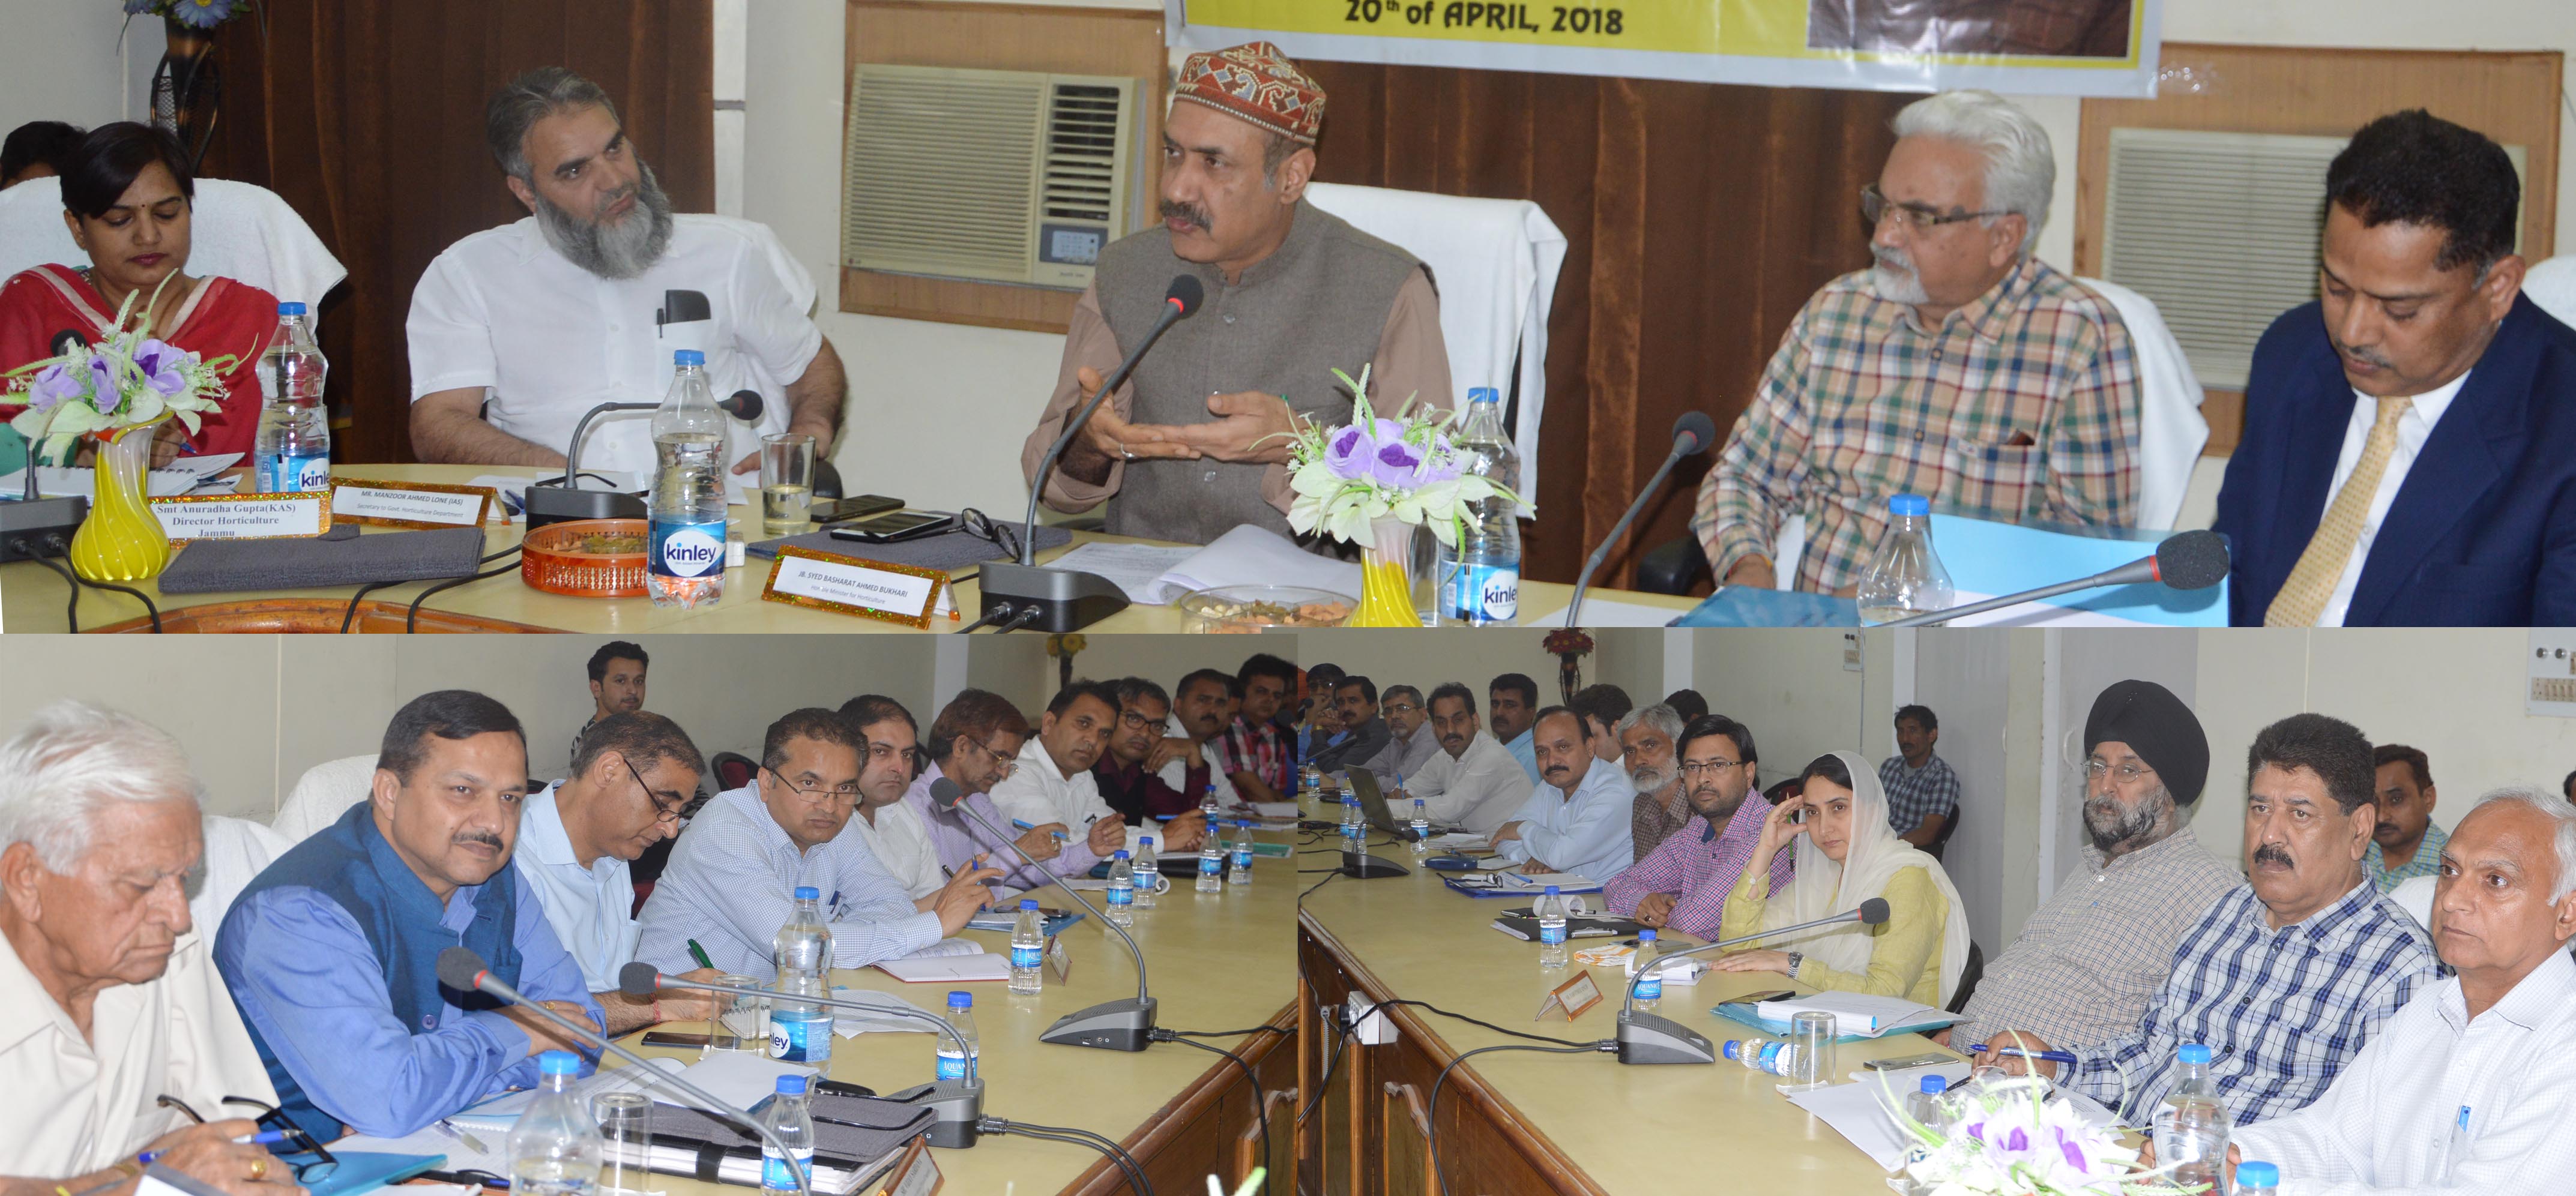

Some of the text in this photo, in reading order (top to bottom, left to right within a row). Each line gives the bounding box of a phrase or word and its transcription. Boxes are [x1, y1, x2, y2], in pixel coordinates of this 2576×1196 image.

[1406, 1, 1434, 25] of
[1444, 1, 1539, 33] APRIL,
[1551, 7, 1623, 35] 2018
[301, 470, 330, 488] kinle
[374, 491, 406, 500] MANZOOR
[448, 497, 463, 506] (IAS)
[157, 503, 296, 514] Smt Anuradha Gupta(KAS)
[172, 516, 279, 526] Director Horticulture
[666, 542, 717, 563] kinley
[807, 572, 823, 581] SYED
[823, 575, 857, 586] BASHARAT
[856, 582, 878, 592] AHMED
[879, 586, 908, 598] BUKHARI
[1484, 584, 1517, 604] kinle
[769, 1032, 788, 1050] nley
